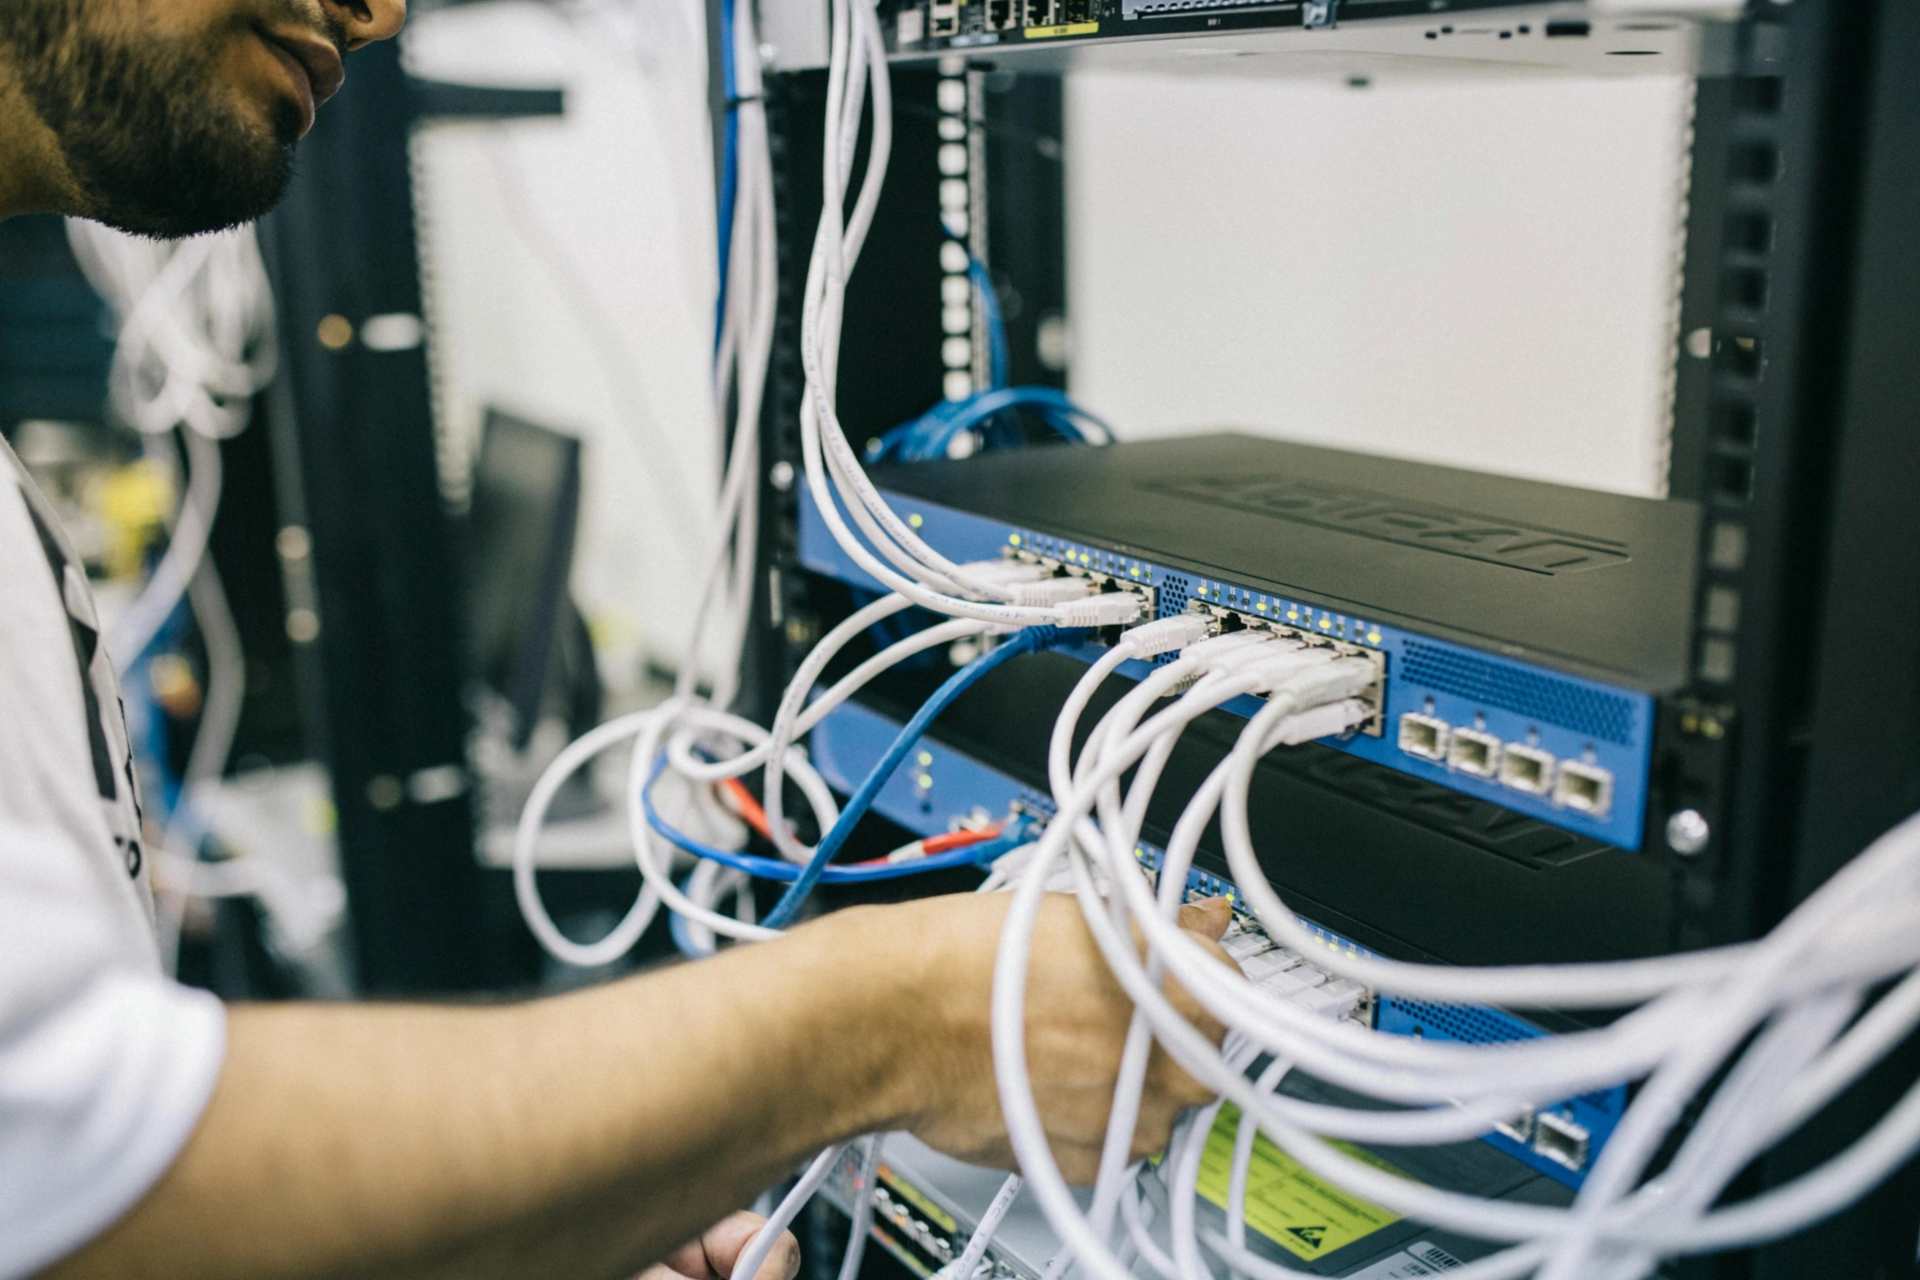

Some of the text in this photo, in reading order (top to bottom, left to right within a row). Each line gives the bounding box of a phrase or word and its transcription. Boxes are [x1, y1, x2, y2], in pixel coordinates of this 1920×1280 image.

[869, 501, 928, 561] CONFORM
[1213, 582, 1220, 591] 14
[1229, 586, 1236, 596] 15
[1243, 590, 1250, 600] 16
